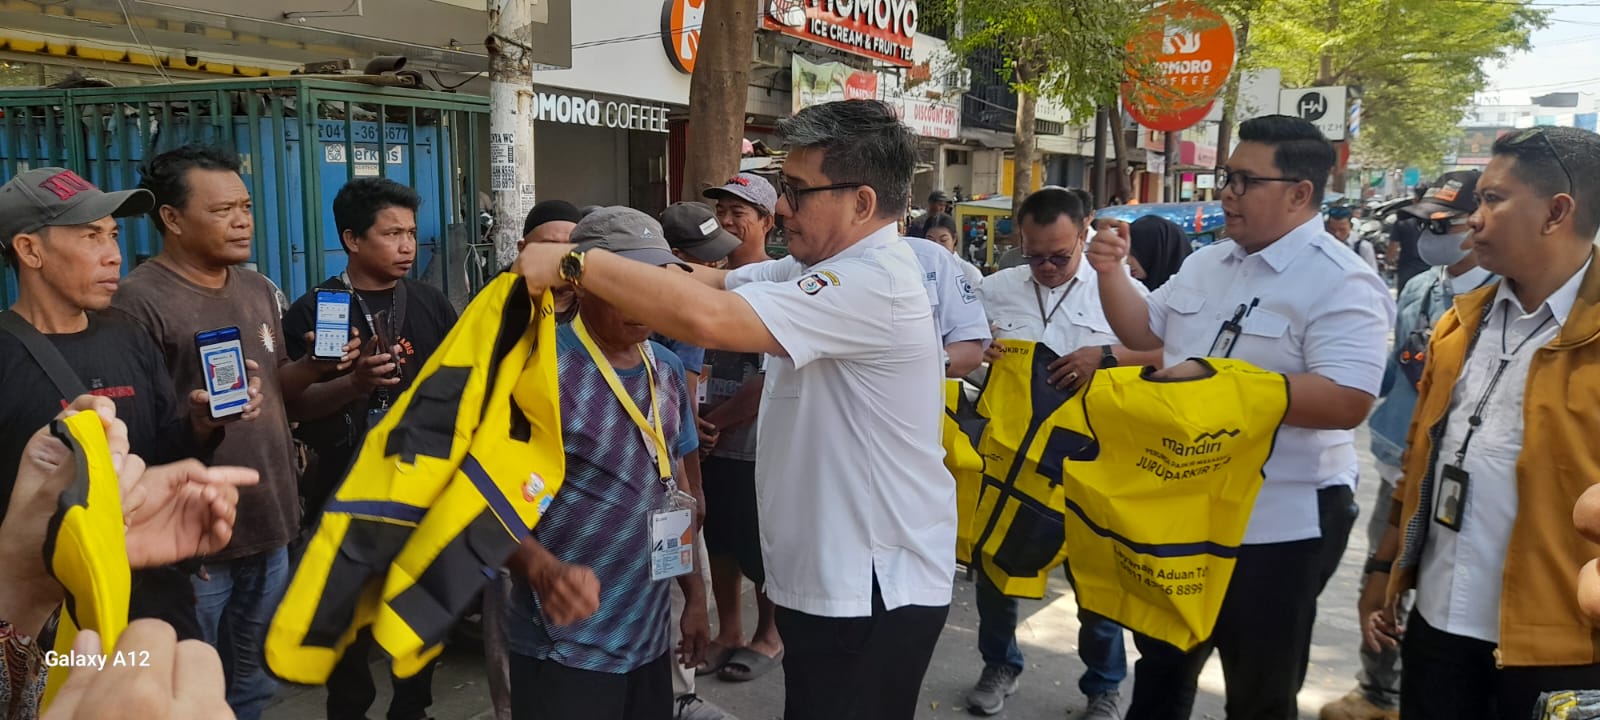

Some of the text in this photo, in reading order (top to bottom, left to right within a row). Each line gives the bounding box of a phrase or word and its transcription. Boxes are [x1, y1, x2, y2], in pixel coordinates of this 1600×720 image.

[811, 18, 828, 37] ICE
[830, 24, 862, 46] CREAM
[865, 35, 872, 49] &
[873, 37, 898, 57] FRUIT
[1152, 60, 1212, 75] OMORO
[1151, 77, 1211, 86] OFFEE
[606, 101, 671, 133] COFFEE
[914, 103, 944, 124] DISCOUNT
[1161, 437, 1223, 457] mandiri
[1135, 455, 1166, 478] JURU
[1156, 568, 1195, 580] Aduan
